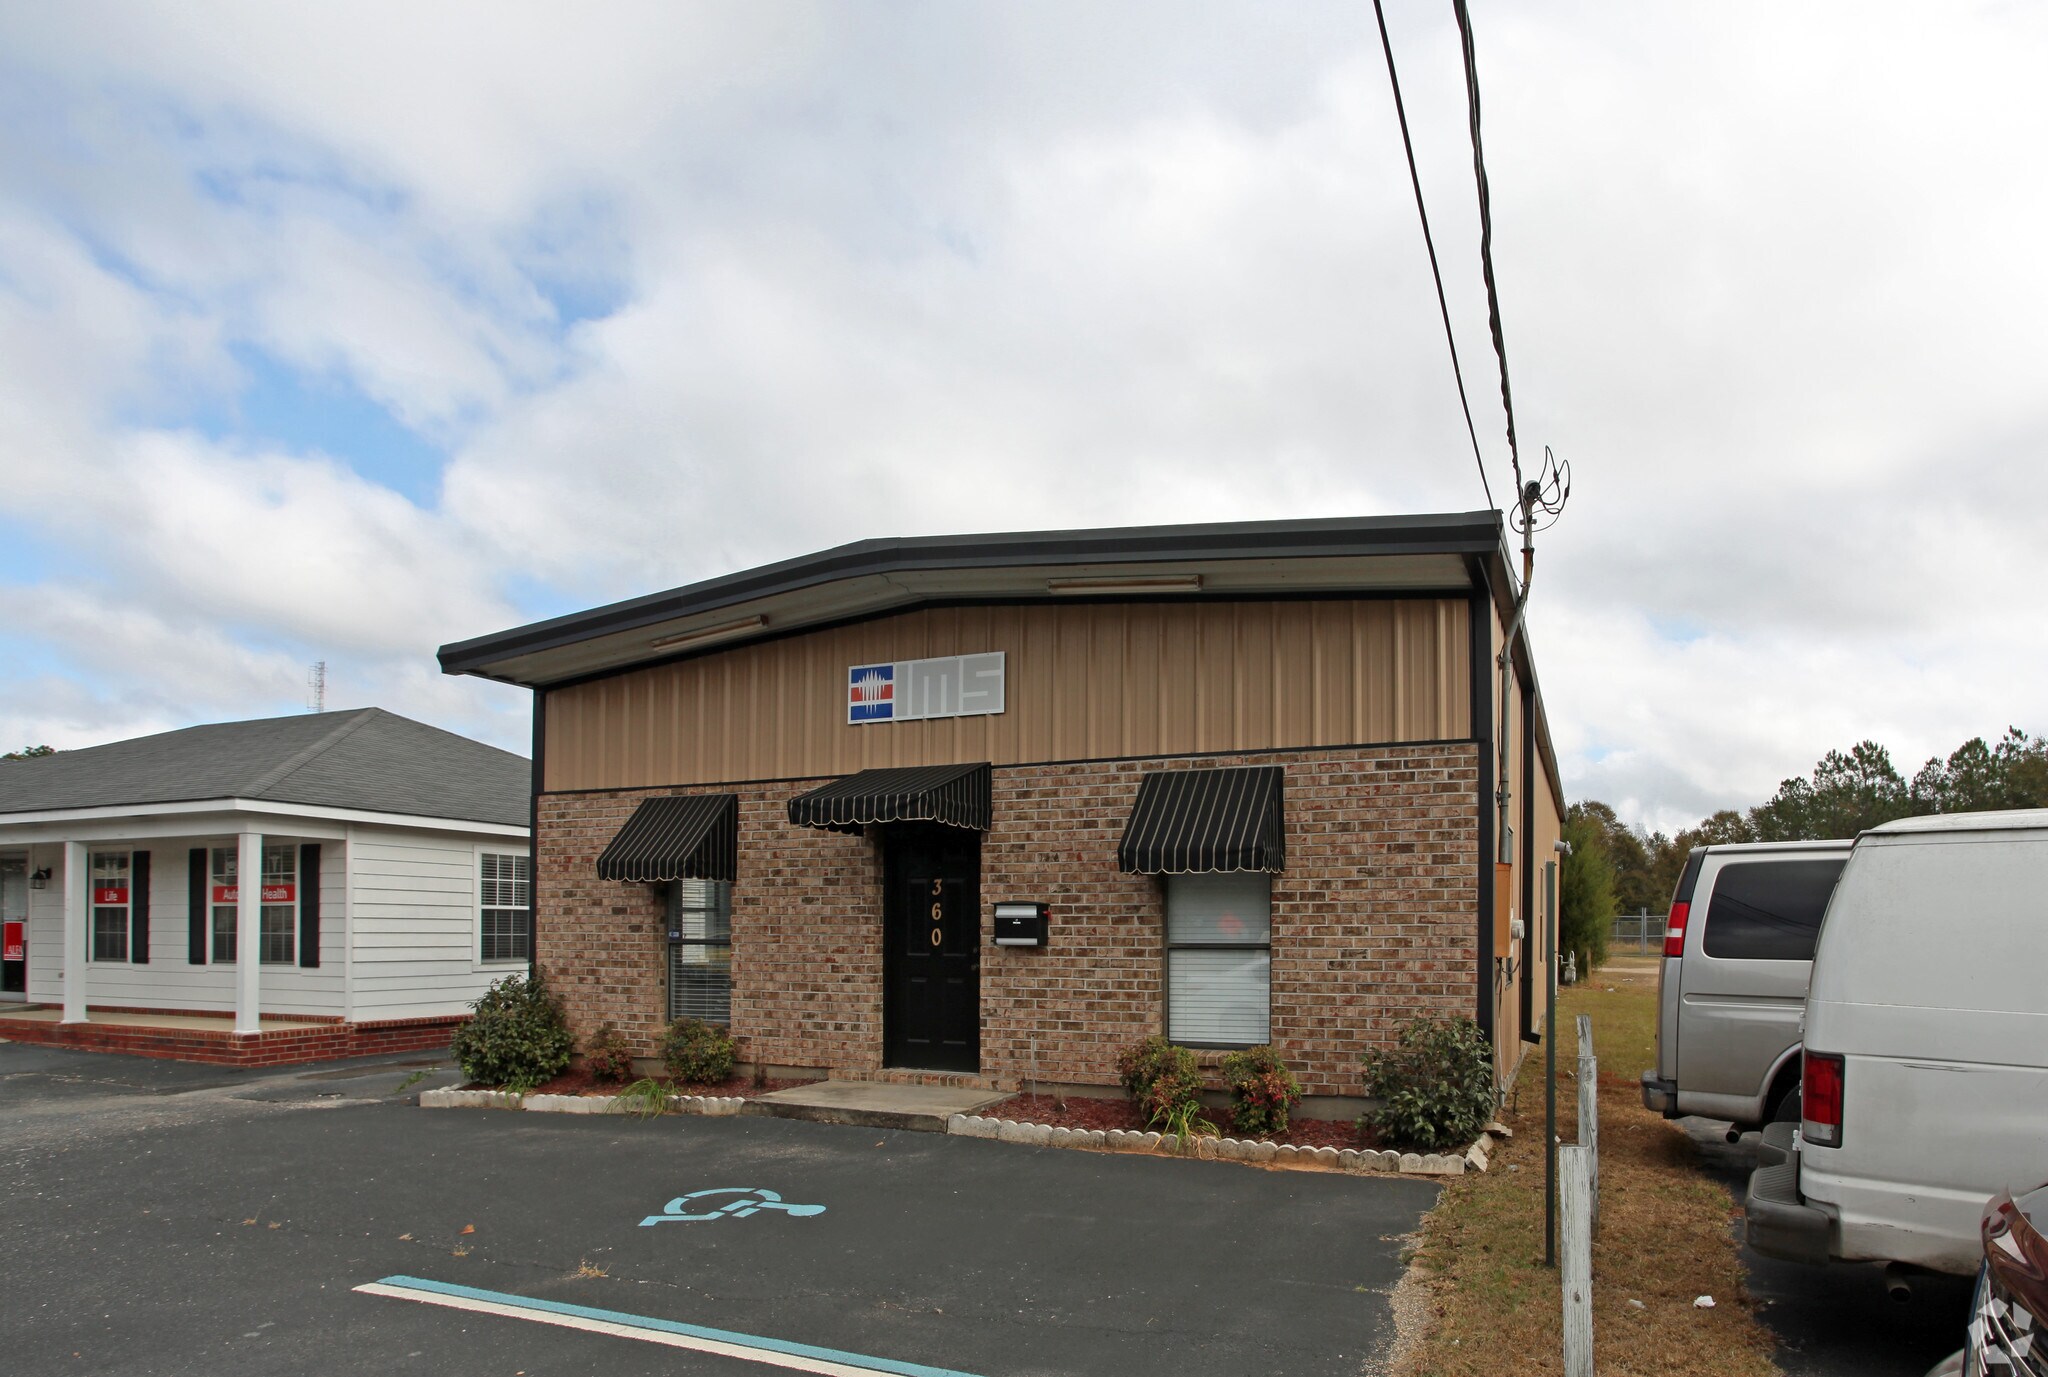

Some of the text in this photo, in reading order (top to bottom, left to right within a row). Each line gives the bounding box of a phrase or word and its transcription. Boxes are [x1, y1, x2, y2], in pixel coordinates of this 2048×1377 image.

[895, 656, 1001, 717] IMS
[104, 890, 118, 901] Life
[262, 887, 288, 900] Health
[931, 878, 943, 947] 360
